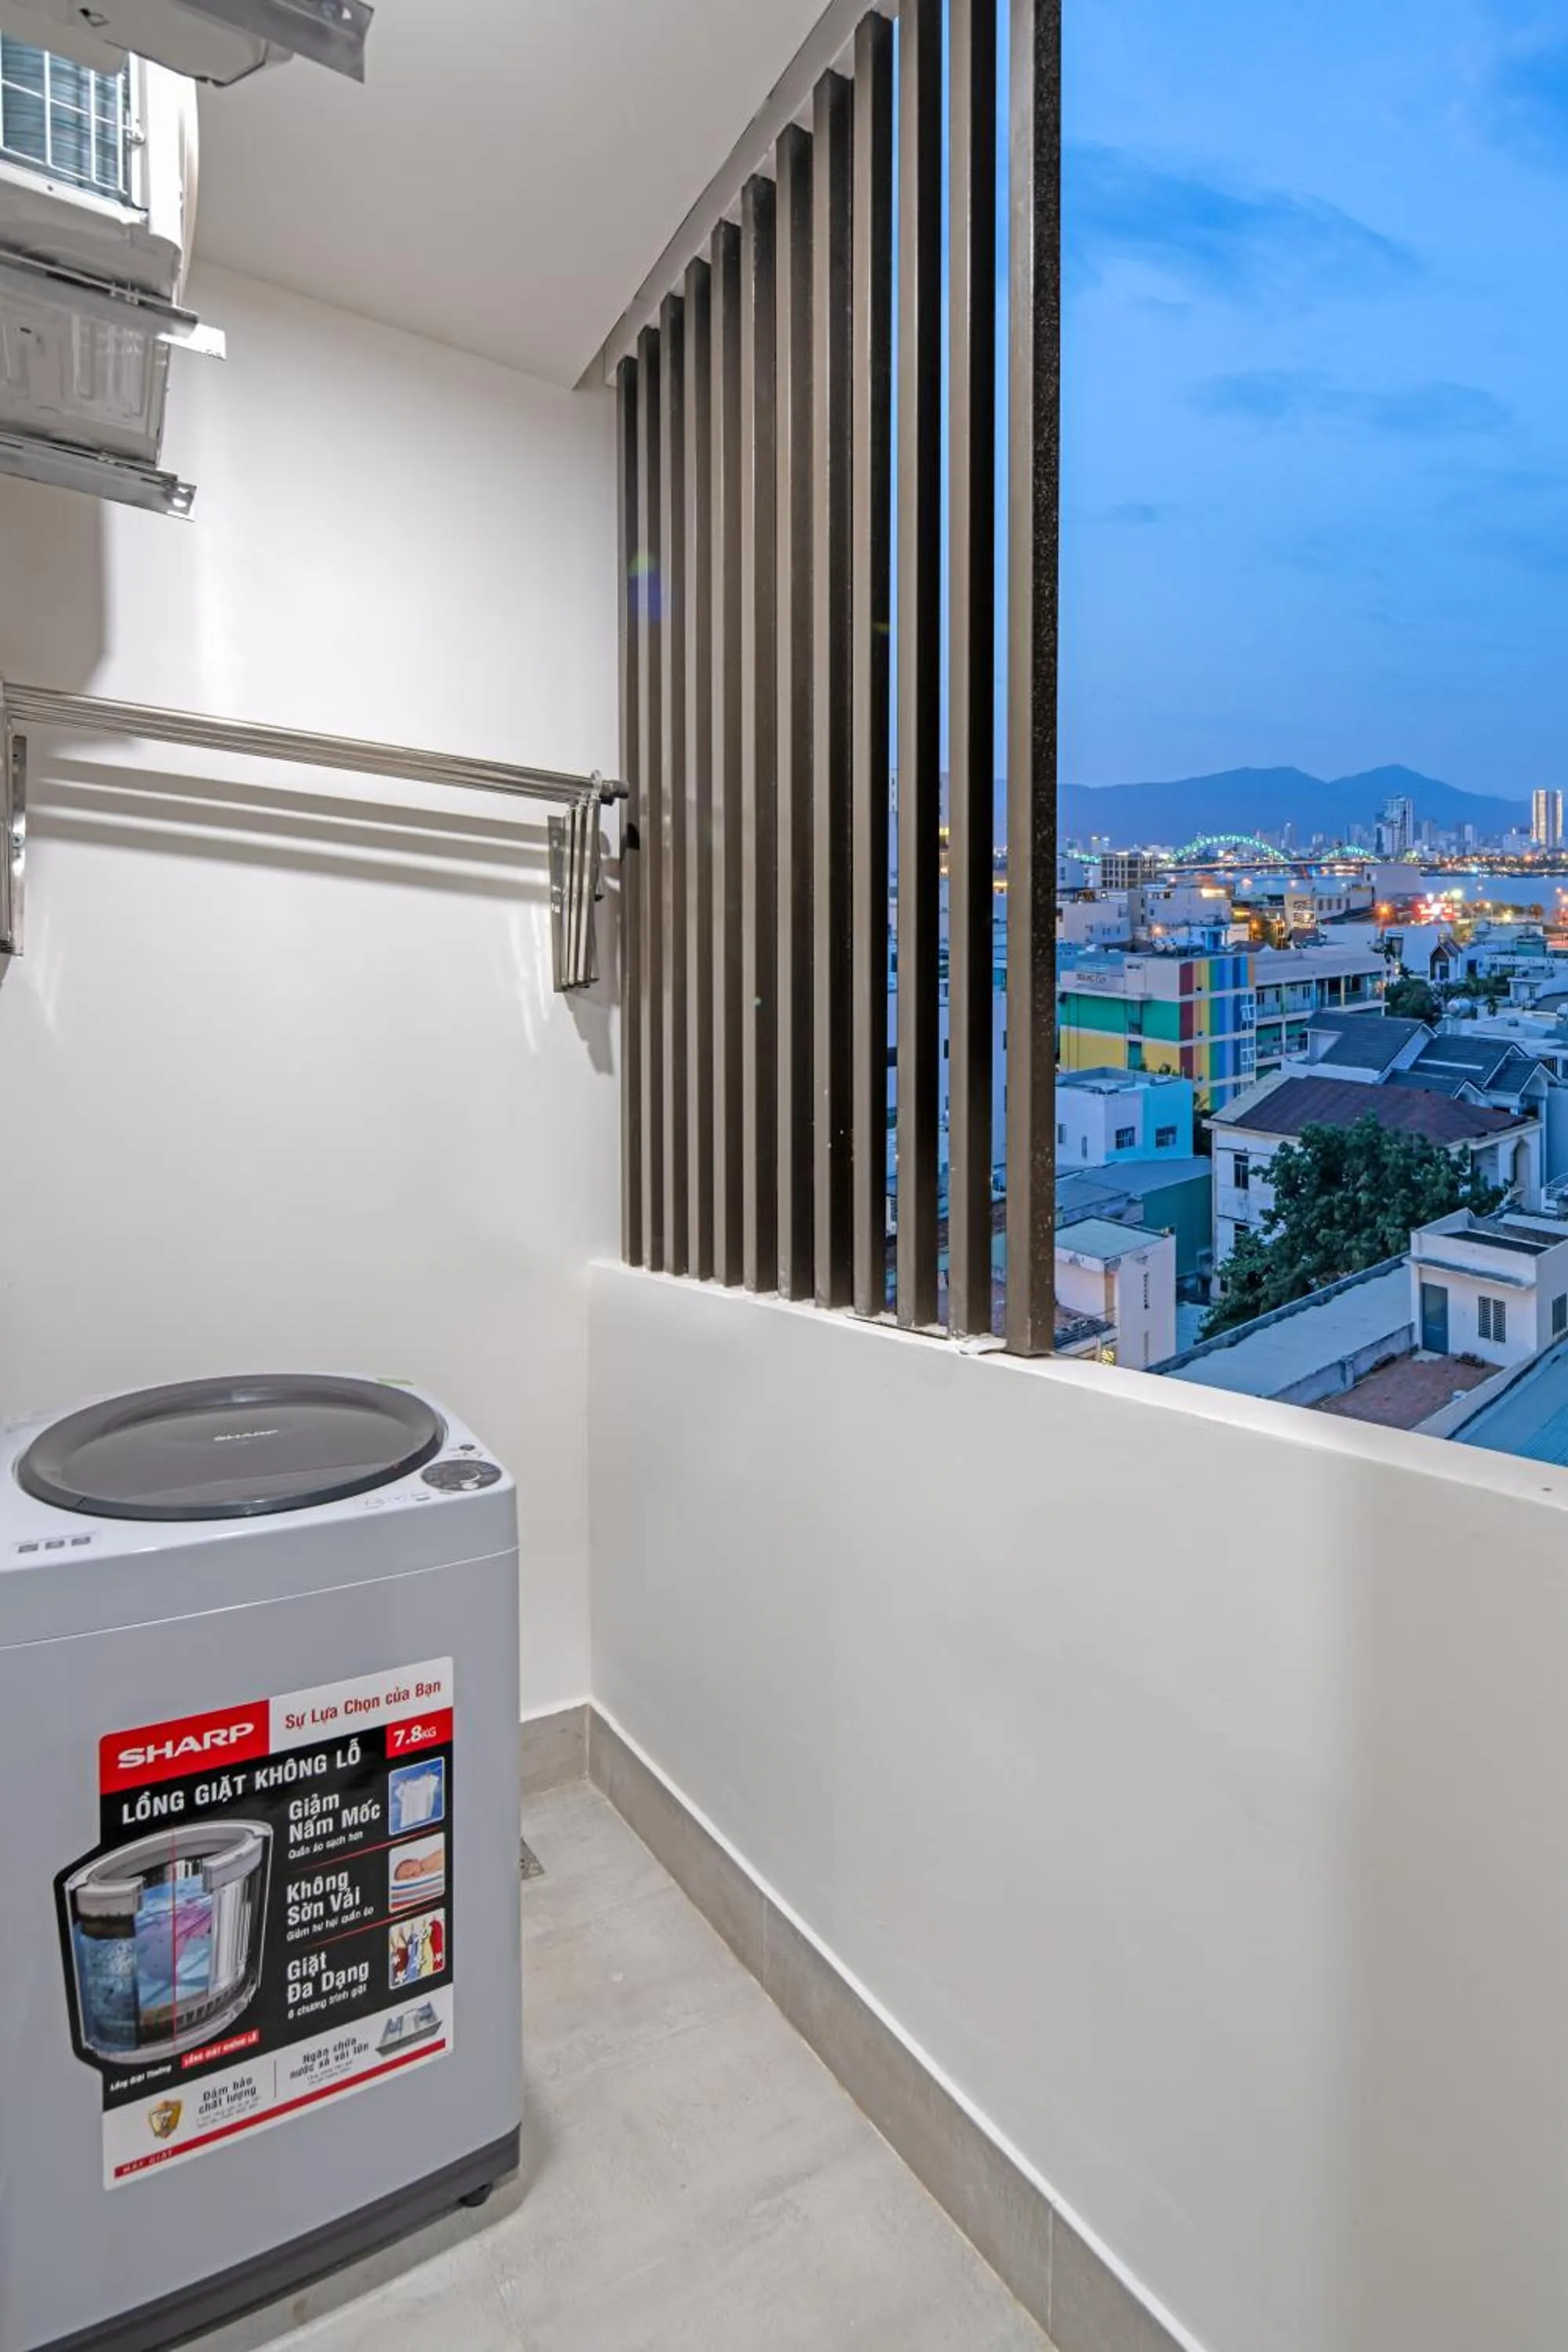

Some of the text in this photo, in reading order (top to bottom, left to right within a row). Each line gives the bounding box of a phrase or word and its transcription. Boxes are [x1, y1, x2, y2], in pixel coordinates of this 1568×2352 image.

[285, 1681, 441, 1730] Sự Lựa Chọn của Bạn
[118, 1722, 254, 1769] SHARP
[122, 1737, 361, 1824] LỒNG GIẶT KHÔNG LỖ
[289, 1793, 339, 1820] Giảm
[289, 1798, 381, 1843] Nấm Mốc
[287, 1871, 349, 1904] Không
[288, 1886, 360, 1926] Sờn Vải
[286, 1961, 369, 2004] Đa Dạng
[287, 1951, 326, 1981] Giặt
